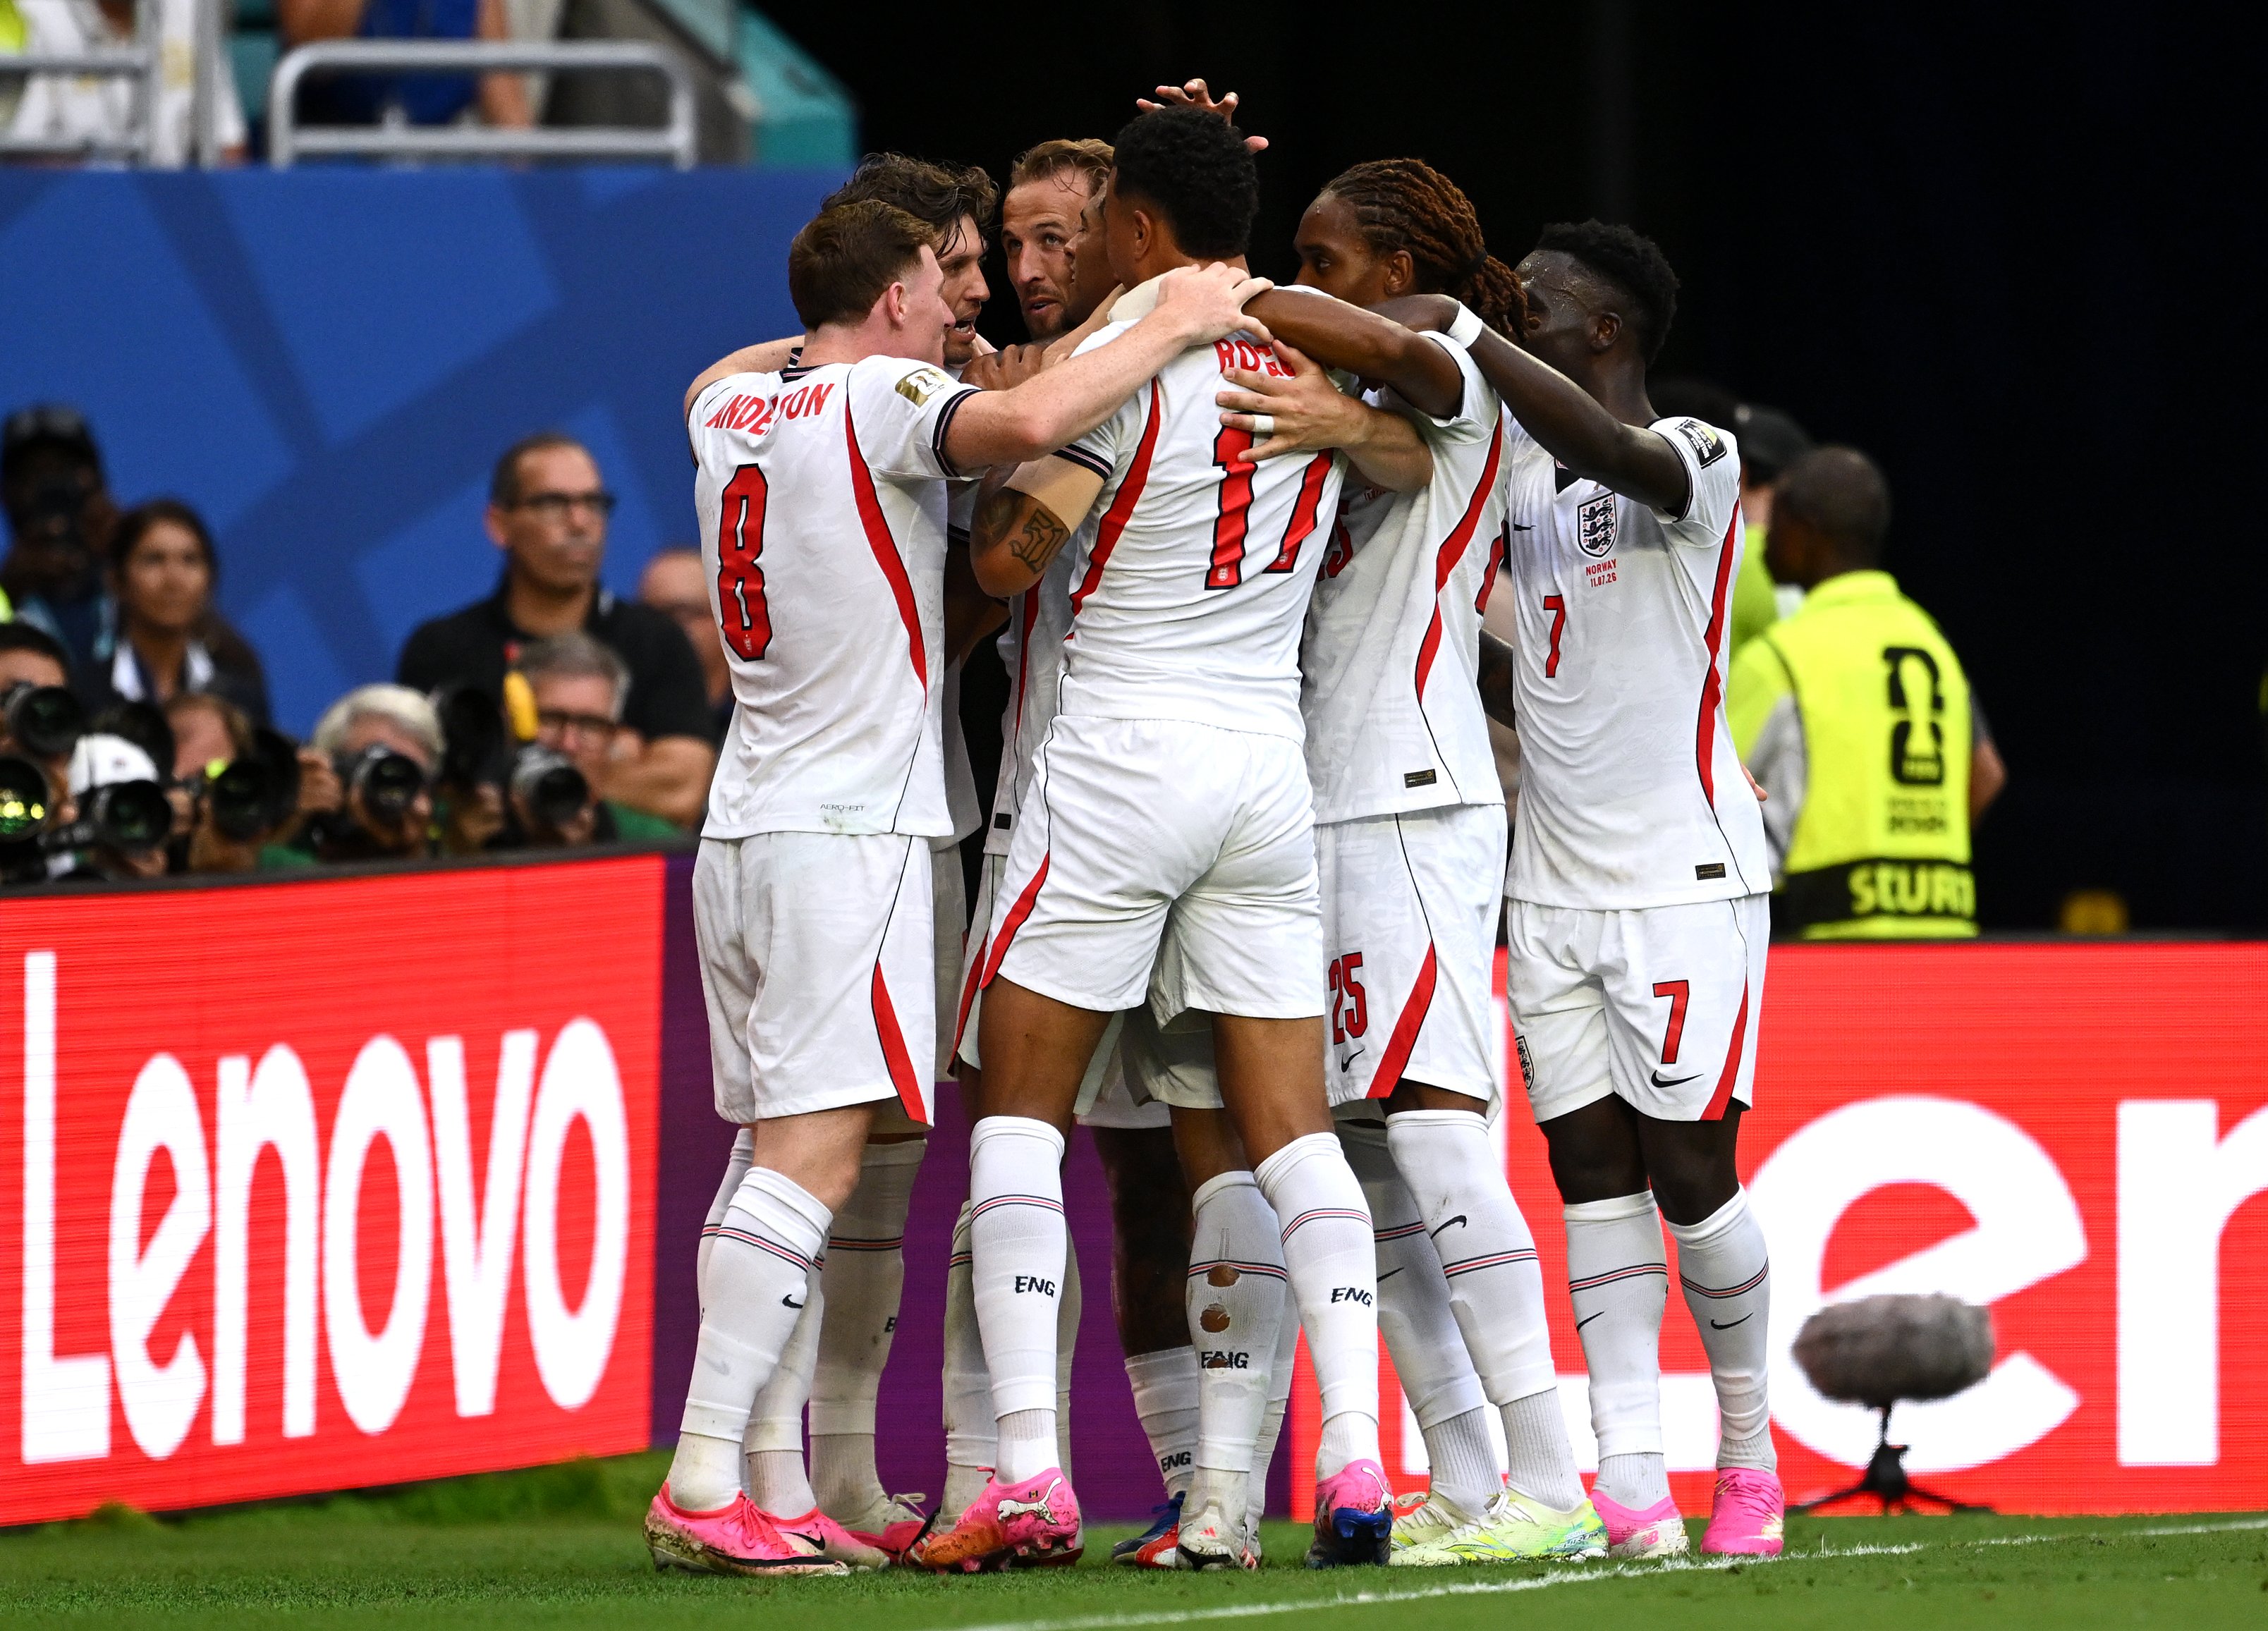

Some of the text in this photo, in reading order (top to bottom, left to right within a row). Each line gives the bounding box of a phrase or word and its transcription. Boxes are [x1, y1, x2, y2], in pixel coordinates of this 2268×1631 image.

[1213, 338, 1296, 377] ROG
[718, 463, 773, 661] 8
[1317, 499, 1353, 582] 5
[1585, 558, 1617, 576] NORWAY
[1590, 572, 1617, 588] 11.07.26
[1544, 594, 1566, 678] 7
[1329, 951, 1368, 1045] 25
[1653, 979, 1690, 1065] 7
[22, 950, 630, 1465] Lenovo
[1015, 1276, 1055, 1297] ENG
[1331, 1287, 1372, 1308] ENG
[1160, 1451, 1191, 1474] ENG
